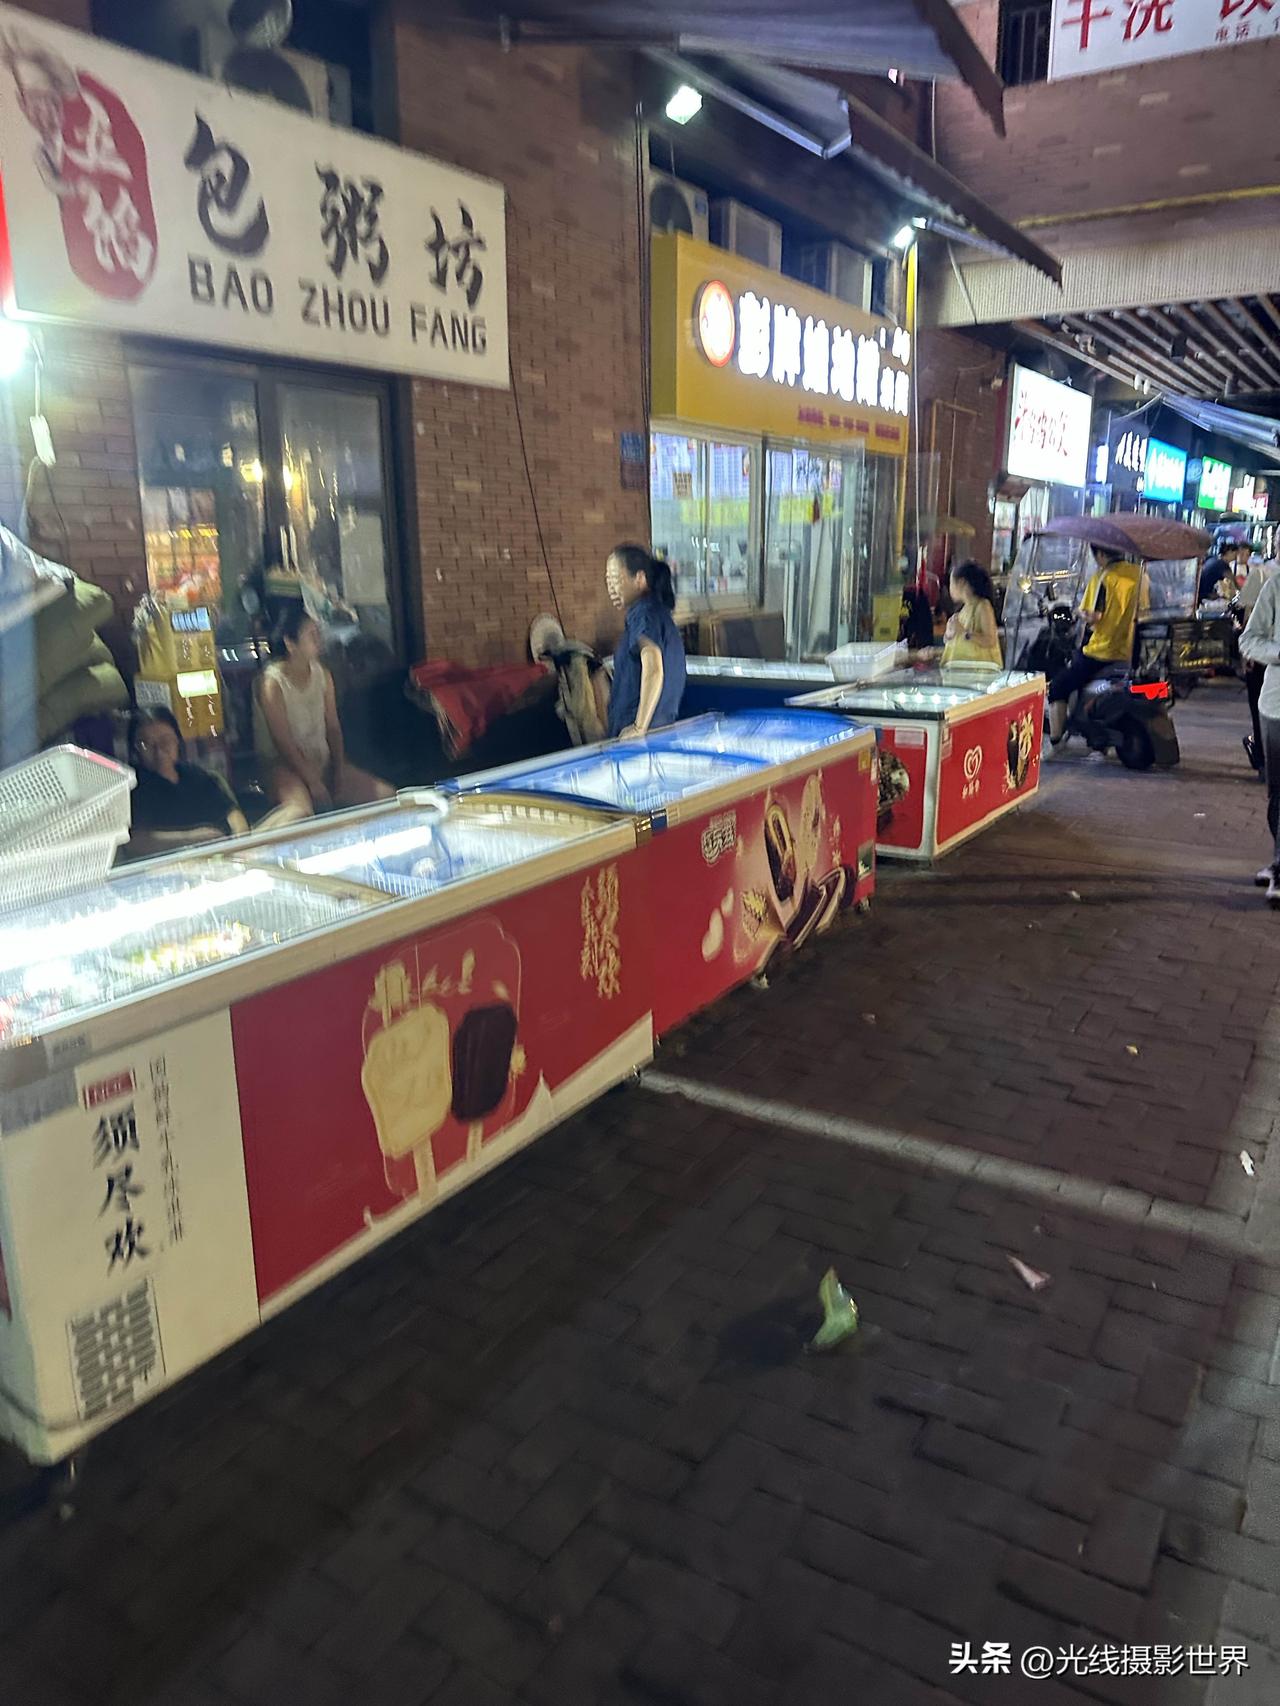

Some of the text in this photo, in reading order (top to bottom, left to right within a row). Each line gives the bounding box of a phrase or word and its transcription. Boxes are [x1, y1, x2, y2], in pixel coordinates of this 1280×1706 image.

[184, 107, 486, 310] 包粥坊
[187, 253, 488, 355] BAO ZHOU FANG
[92, 1101, 150, 1277] 须尽欢
